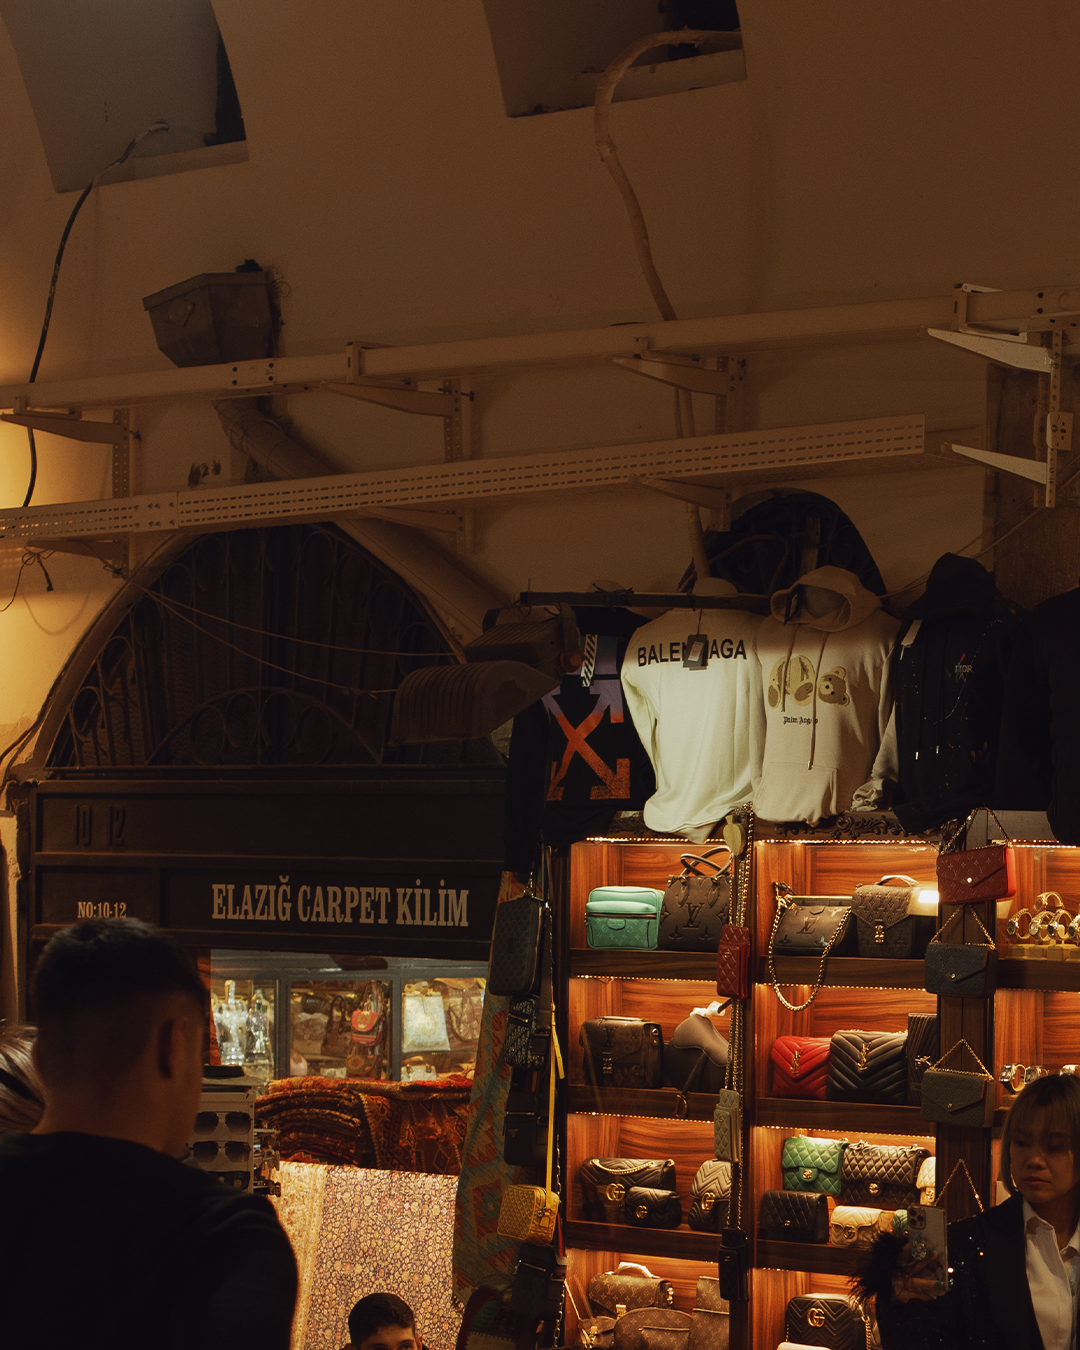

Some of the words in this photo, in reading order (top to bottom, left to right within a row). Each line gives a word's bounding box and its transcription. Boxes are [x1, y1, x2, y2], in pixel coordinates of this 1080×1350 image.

[77, 901, 127, 919] NO:10-12
[211, 874, 292, 922] ELAZIĞ
[297, 885, 392, 924] CARPET
[395, 878, 469, 927] KİLİM
